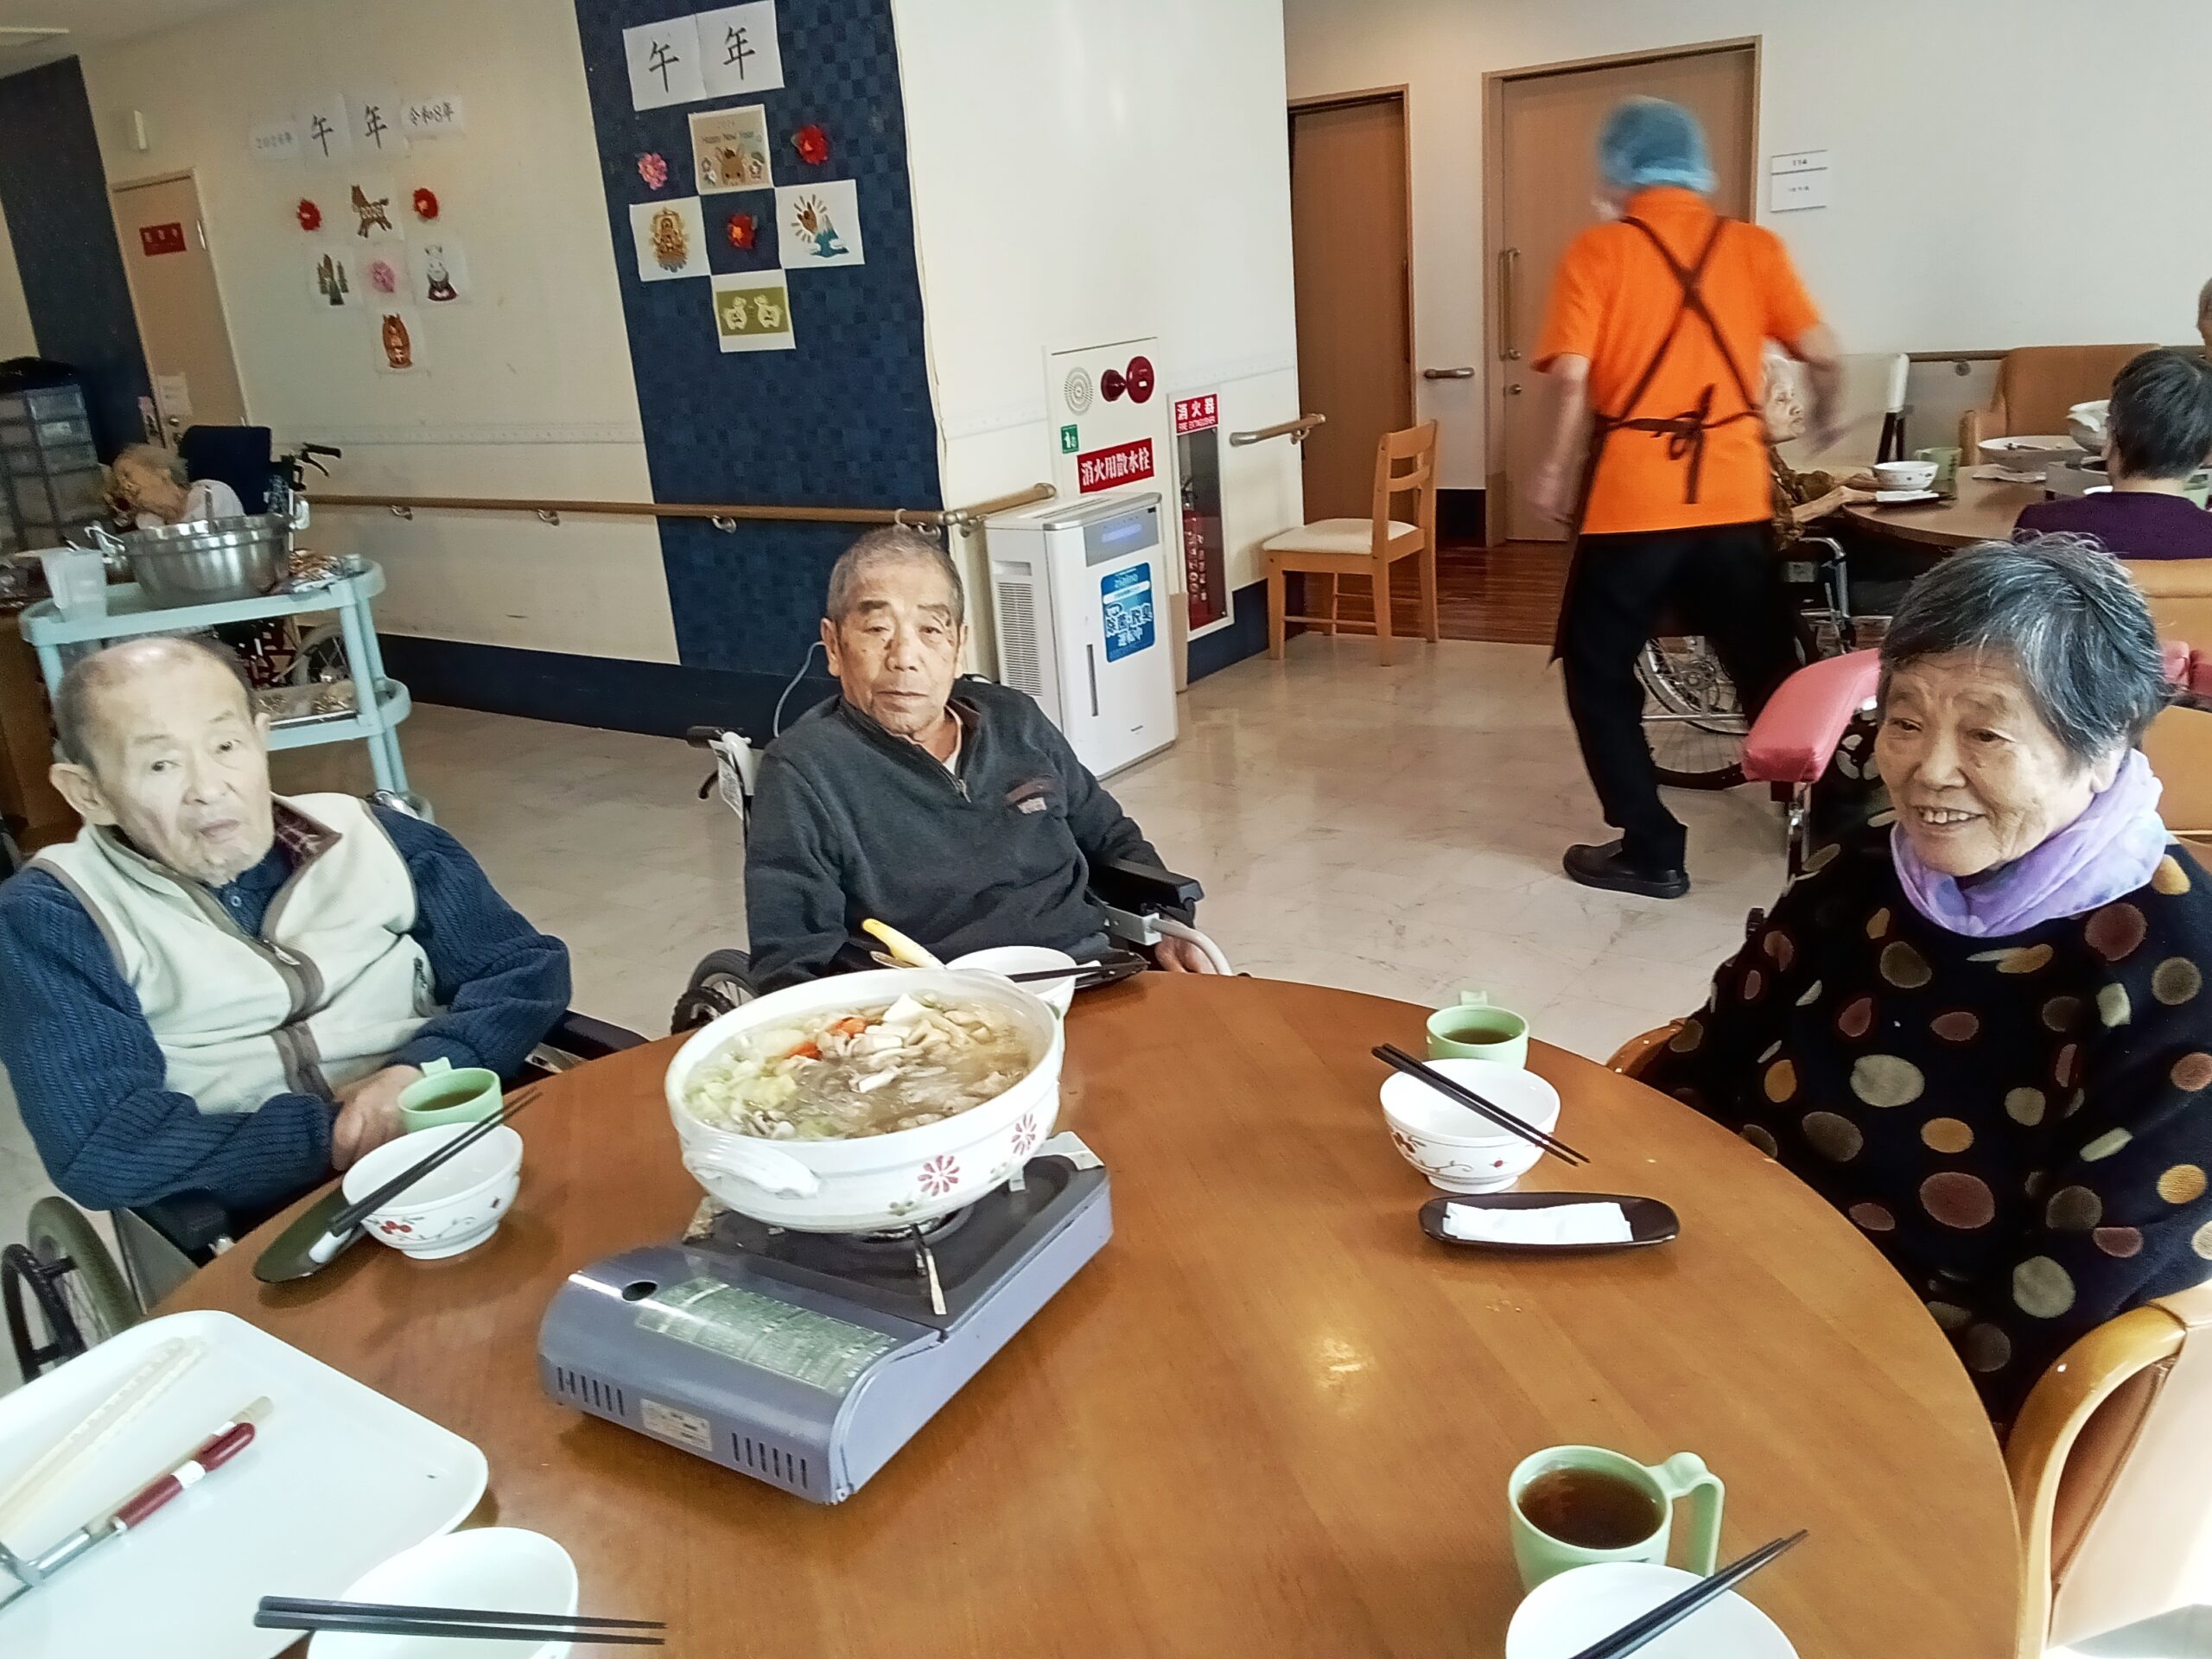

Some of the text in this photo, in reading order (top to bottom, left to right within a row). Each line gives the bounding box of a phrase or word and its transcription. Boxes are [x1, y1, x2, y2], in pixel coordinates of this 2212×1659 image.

[648, 26, 756, 93] 午年
[311, 104, 388, 157] 午年
[1177, 397, 1215, 421] 消火器
[1080, 447, 1151, 486] 消火用散水栓
